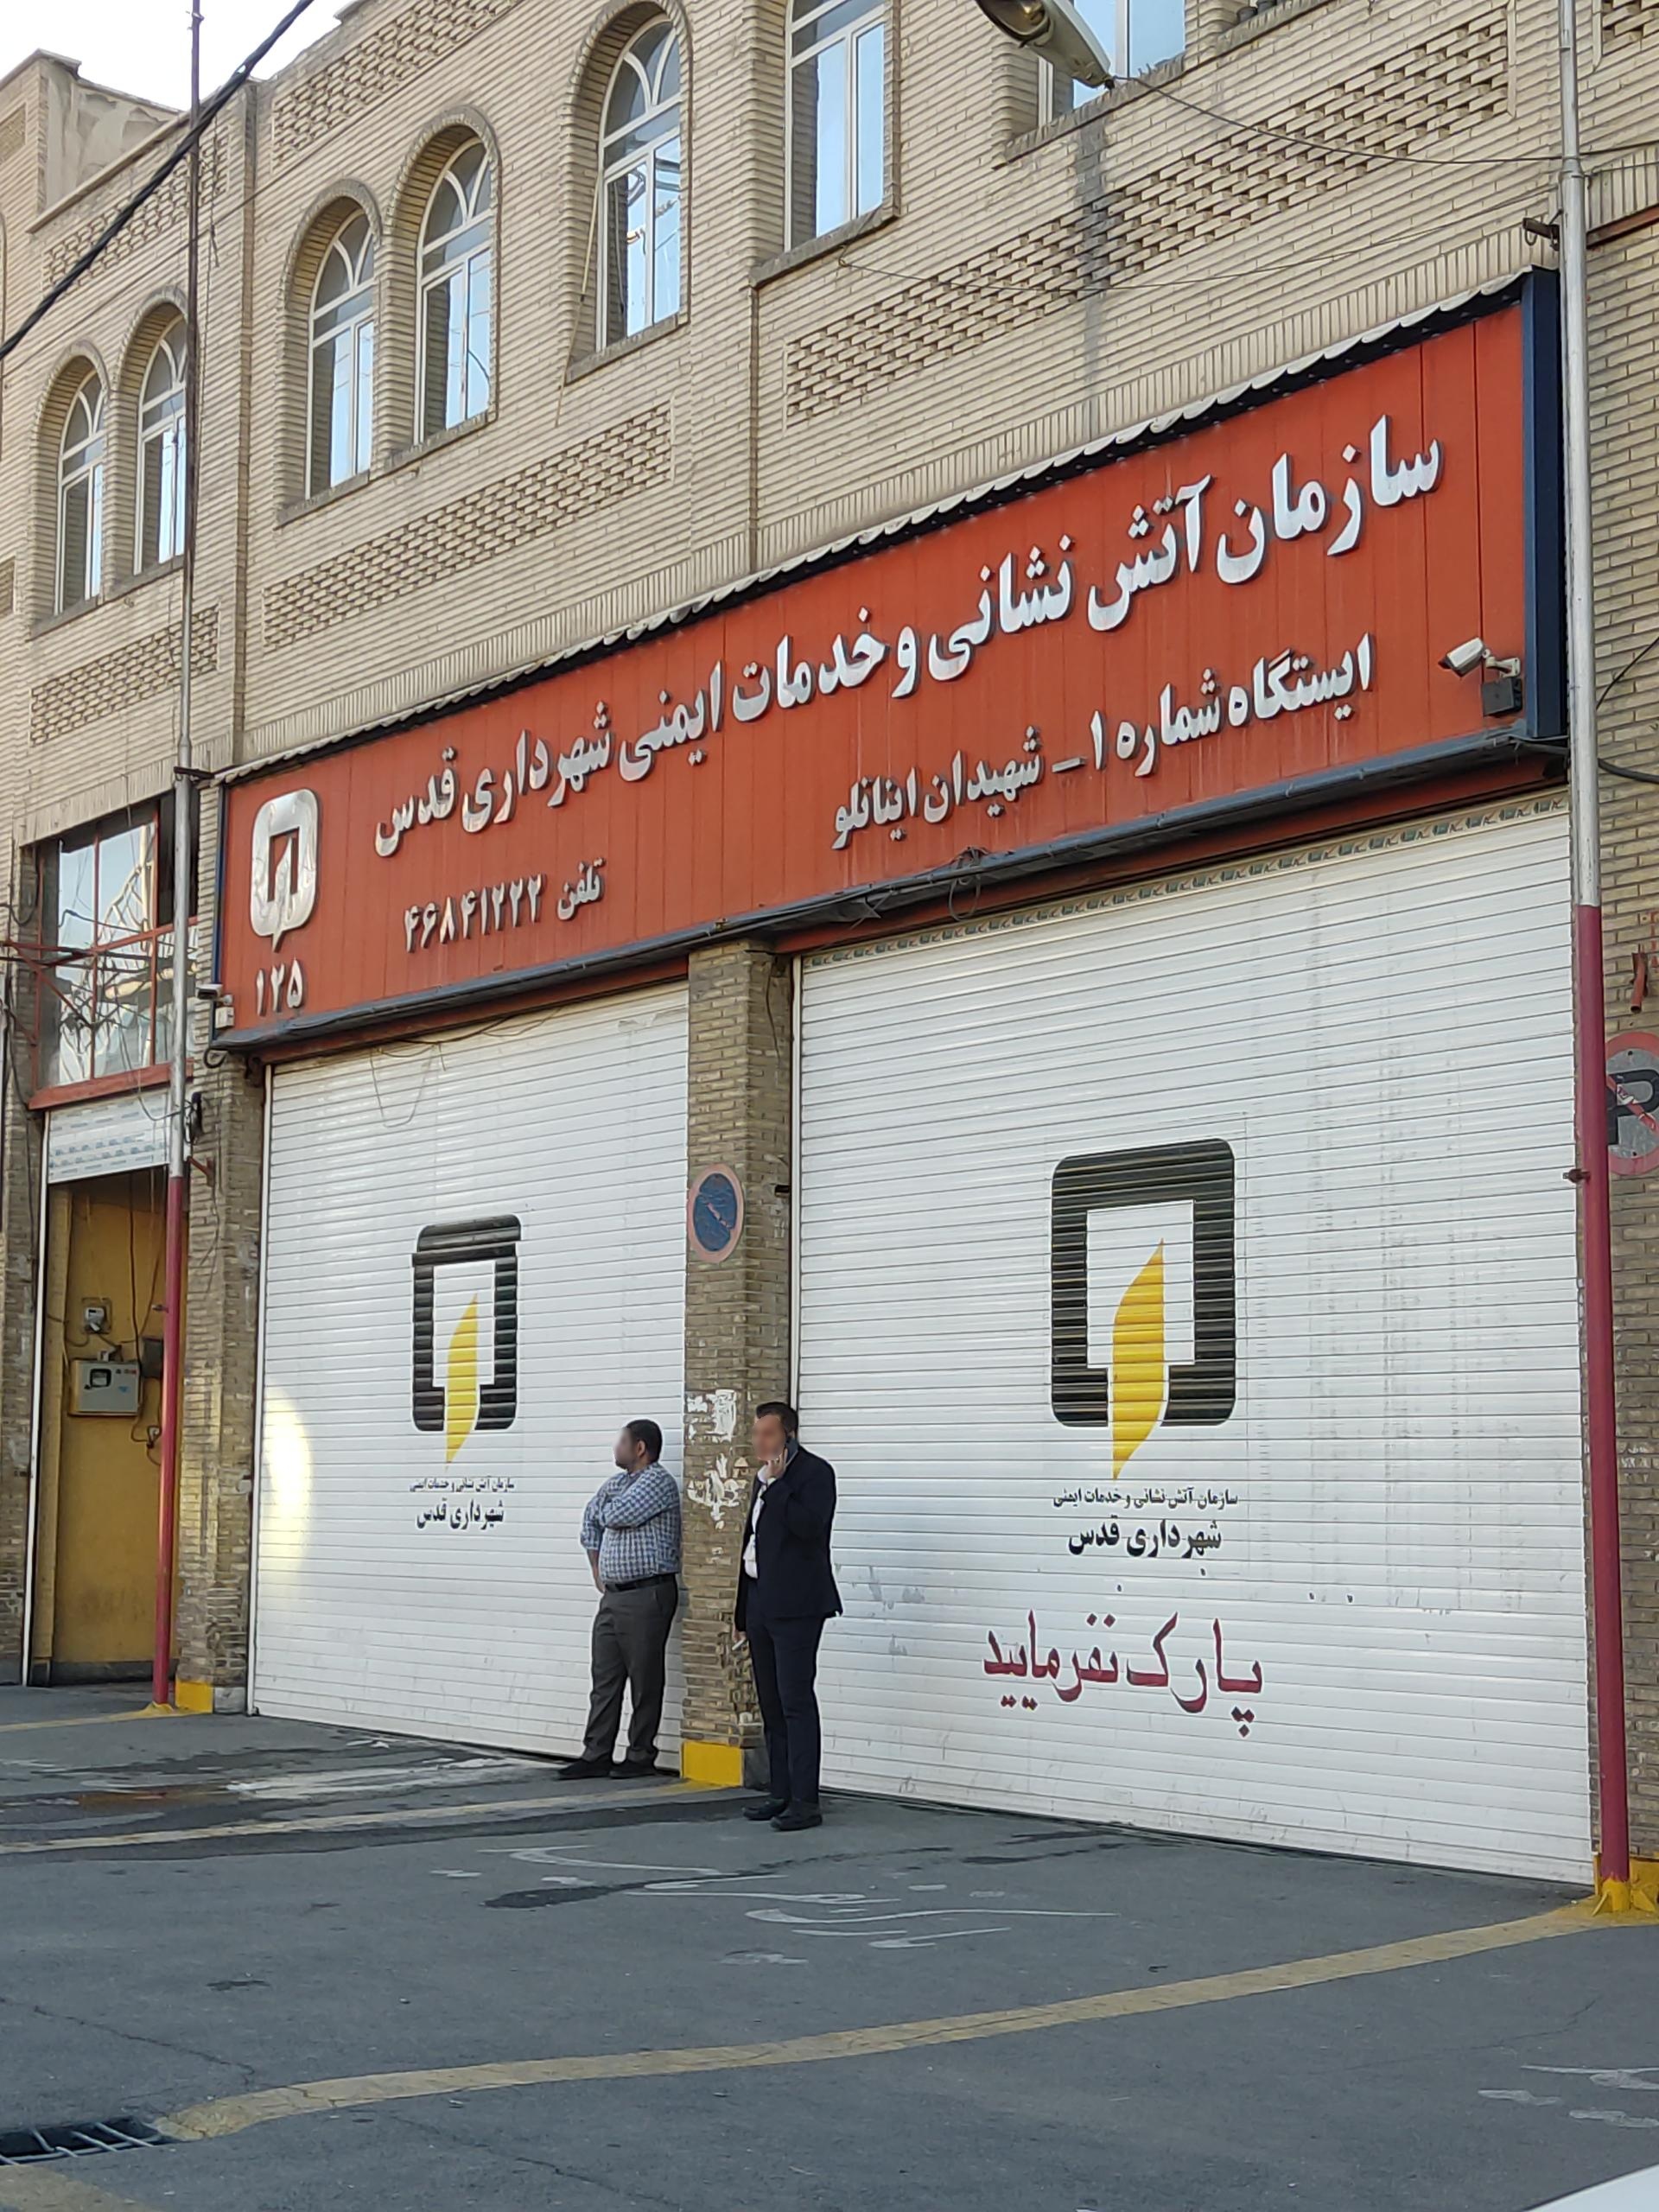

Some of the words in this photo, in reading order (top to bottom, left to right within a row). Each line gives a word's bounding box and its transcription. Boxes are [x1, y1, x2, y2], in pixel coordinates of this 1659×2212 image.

[1216, 414, 1443, 584] سازمان
[1087, 473, 1212, 632] آتش
[927, 534, 1074, 683] نشانی
[732, 607, 893, 723] خدمات
[891, 626, 917, 698] و
[1228, 632, 1372, 722] ایستگاه
[619, 659, 722, 783] ایمنی
[1116, 668, 1220, 778] شماره
[373, 746, 457, 857] قدس
[461, 701, 613, 835] شهرداری
[923, 726, 1042, 818] شهیدان
[404, 874, 543, 954] ۴۶۸۴۱۲۲۲
[556, 857, 606, 921] تلفن
[256, 957, 305, 1017] ۱۲۵
[416, 1497, 448, 1529] قدس
[449, 1498, 505, 1530] شهرداری
[1052, 1486, 1082, 1508] ایمنی
[1084, 1486, 1122, 1504] خدمات
[1123, 1495, 1131, 1510] و
[1133, 1487, 1166, 1510] نشانی
[1167, 1486, 1194, 1510] آتش
[1197, 1488, 1239, 1510] سازمان
[1068, 1514, 1121, 1556] قدس
[1126, 1517, 1223, 1560] شهرداری
[982, 1608, 1120, 1711] نفرمایید
[1125, 1610, 1264, 1738] پارک
